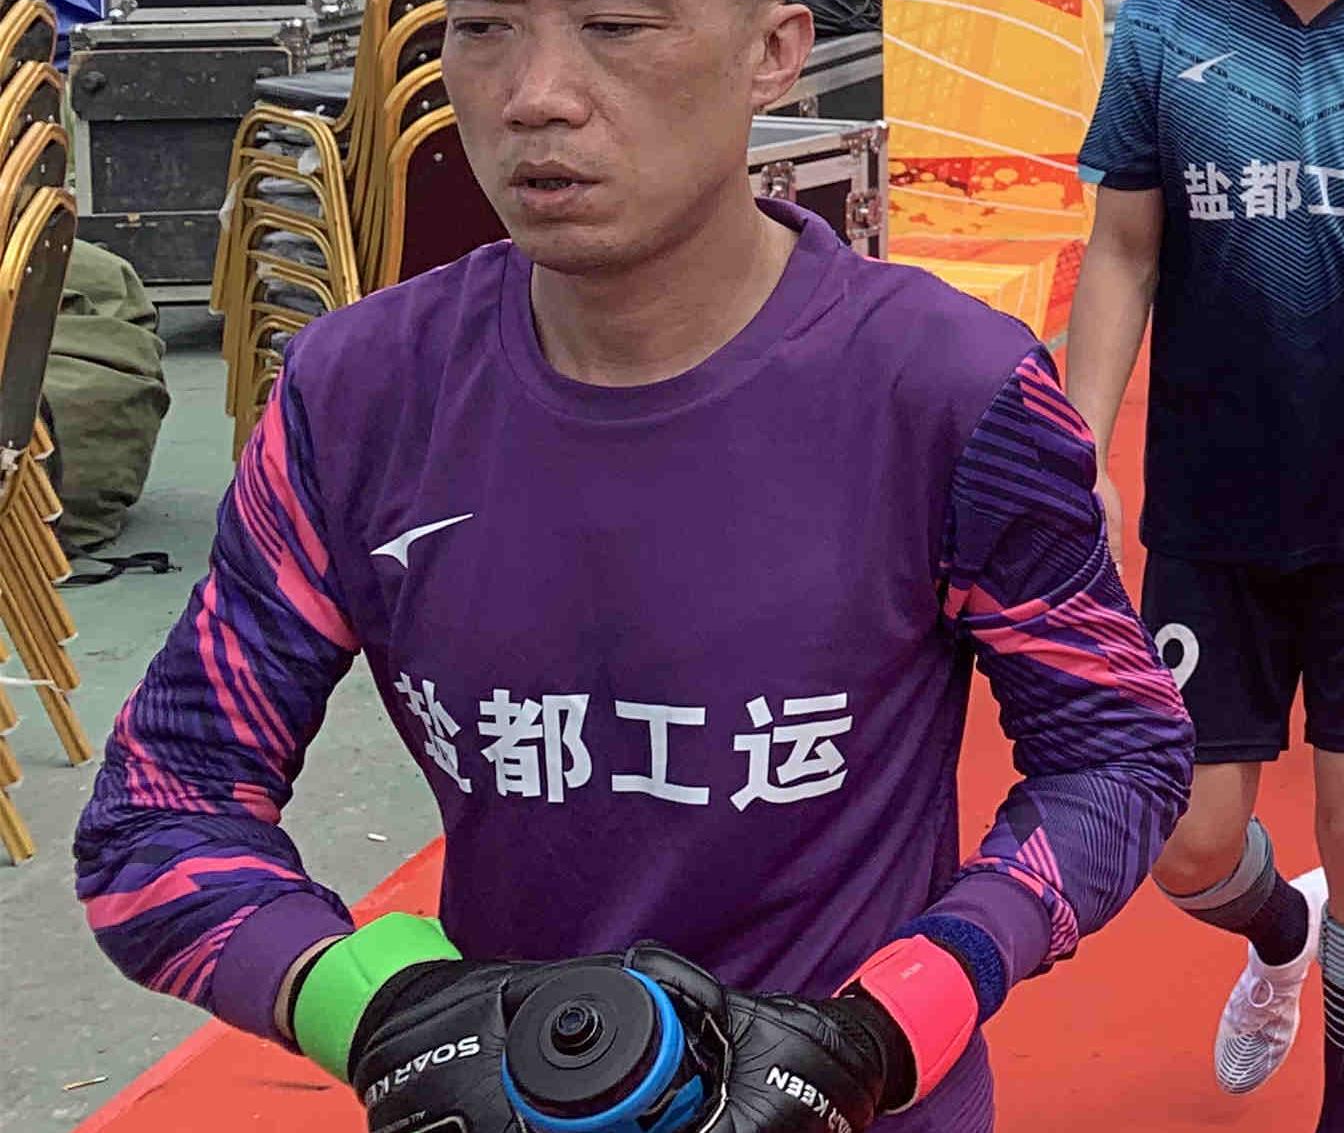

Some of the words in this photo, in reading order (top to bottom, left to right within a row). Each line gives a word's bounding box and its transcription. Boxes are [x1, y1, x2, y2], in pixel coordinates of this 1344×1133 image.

[394, 671, 853, 812] 盐都工运
[394, 1035, 481, 1086] SOAR
[766, 1066, 829, 1118] KEEN
